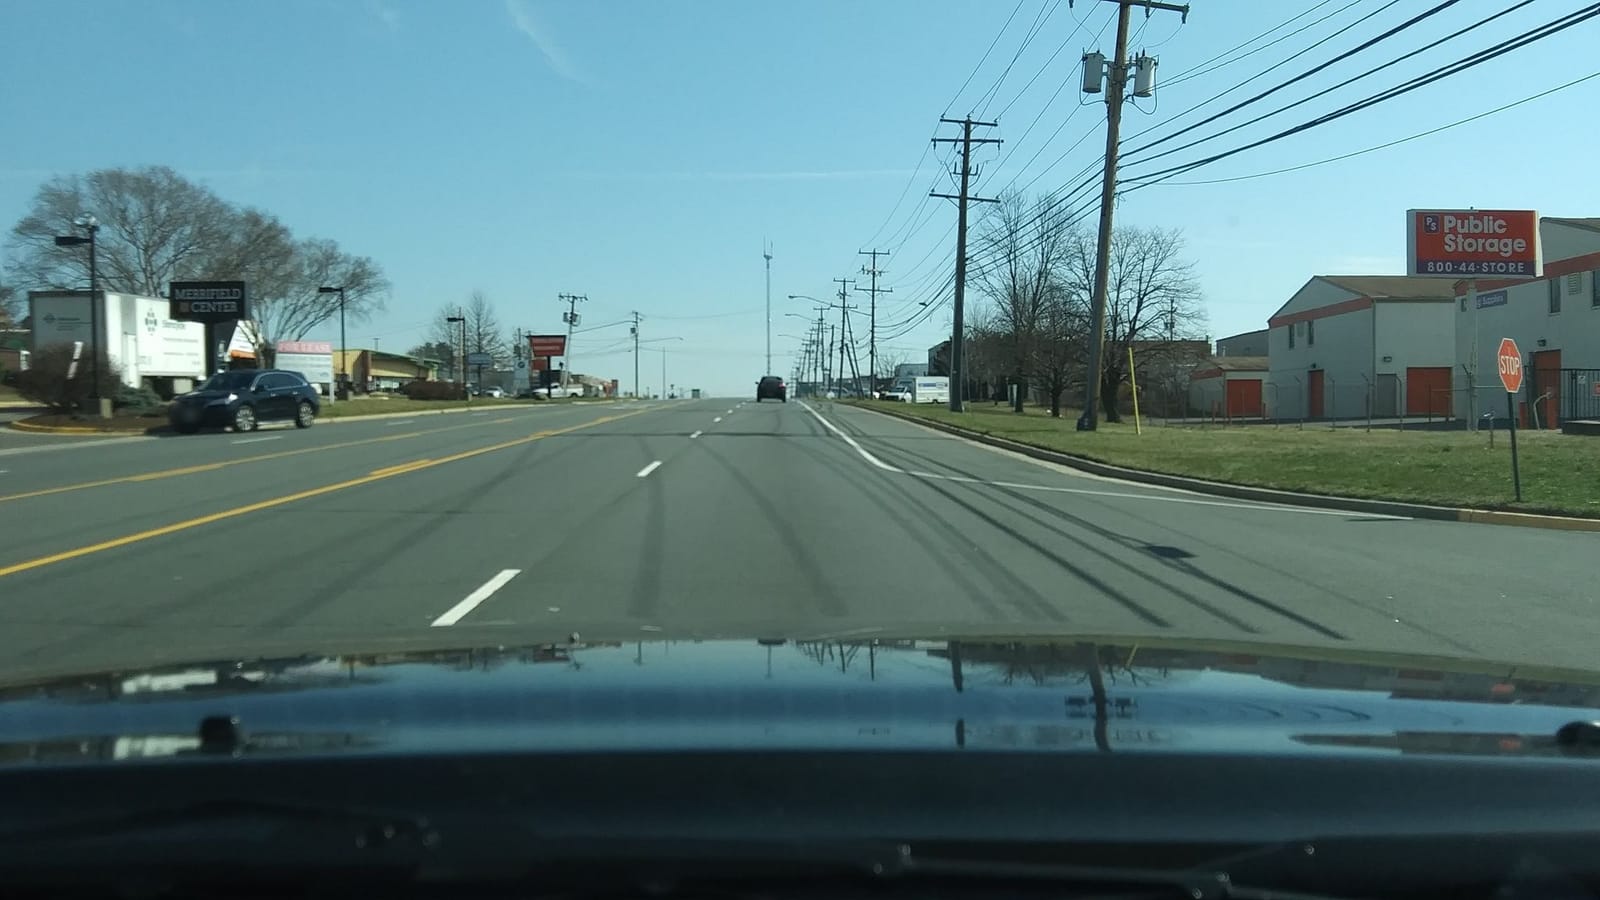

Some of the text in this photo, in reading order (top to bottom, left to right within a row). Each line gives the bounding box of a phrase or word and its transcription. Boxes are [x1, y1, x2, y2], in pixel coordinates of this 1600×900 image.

[1443, 215, 1508, 234] Public
[1443, 233, 1526, 257] Storage
[175, 288, 241, 300] MERRIFIELD
[191, 301, 238, 313] CENTER
[1500, 355, 1520, 376] STOP
